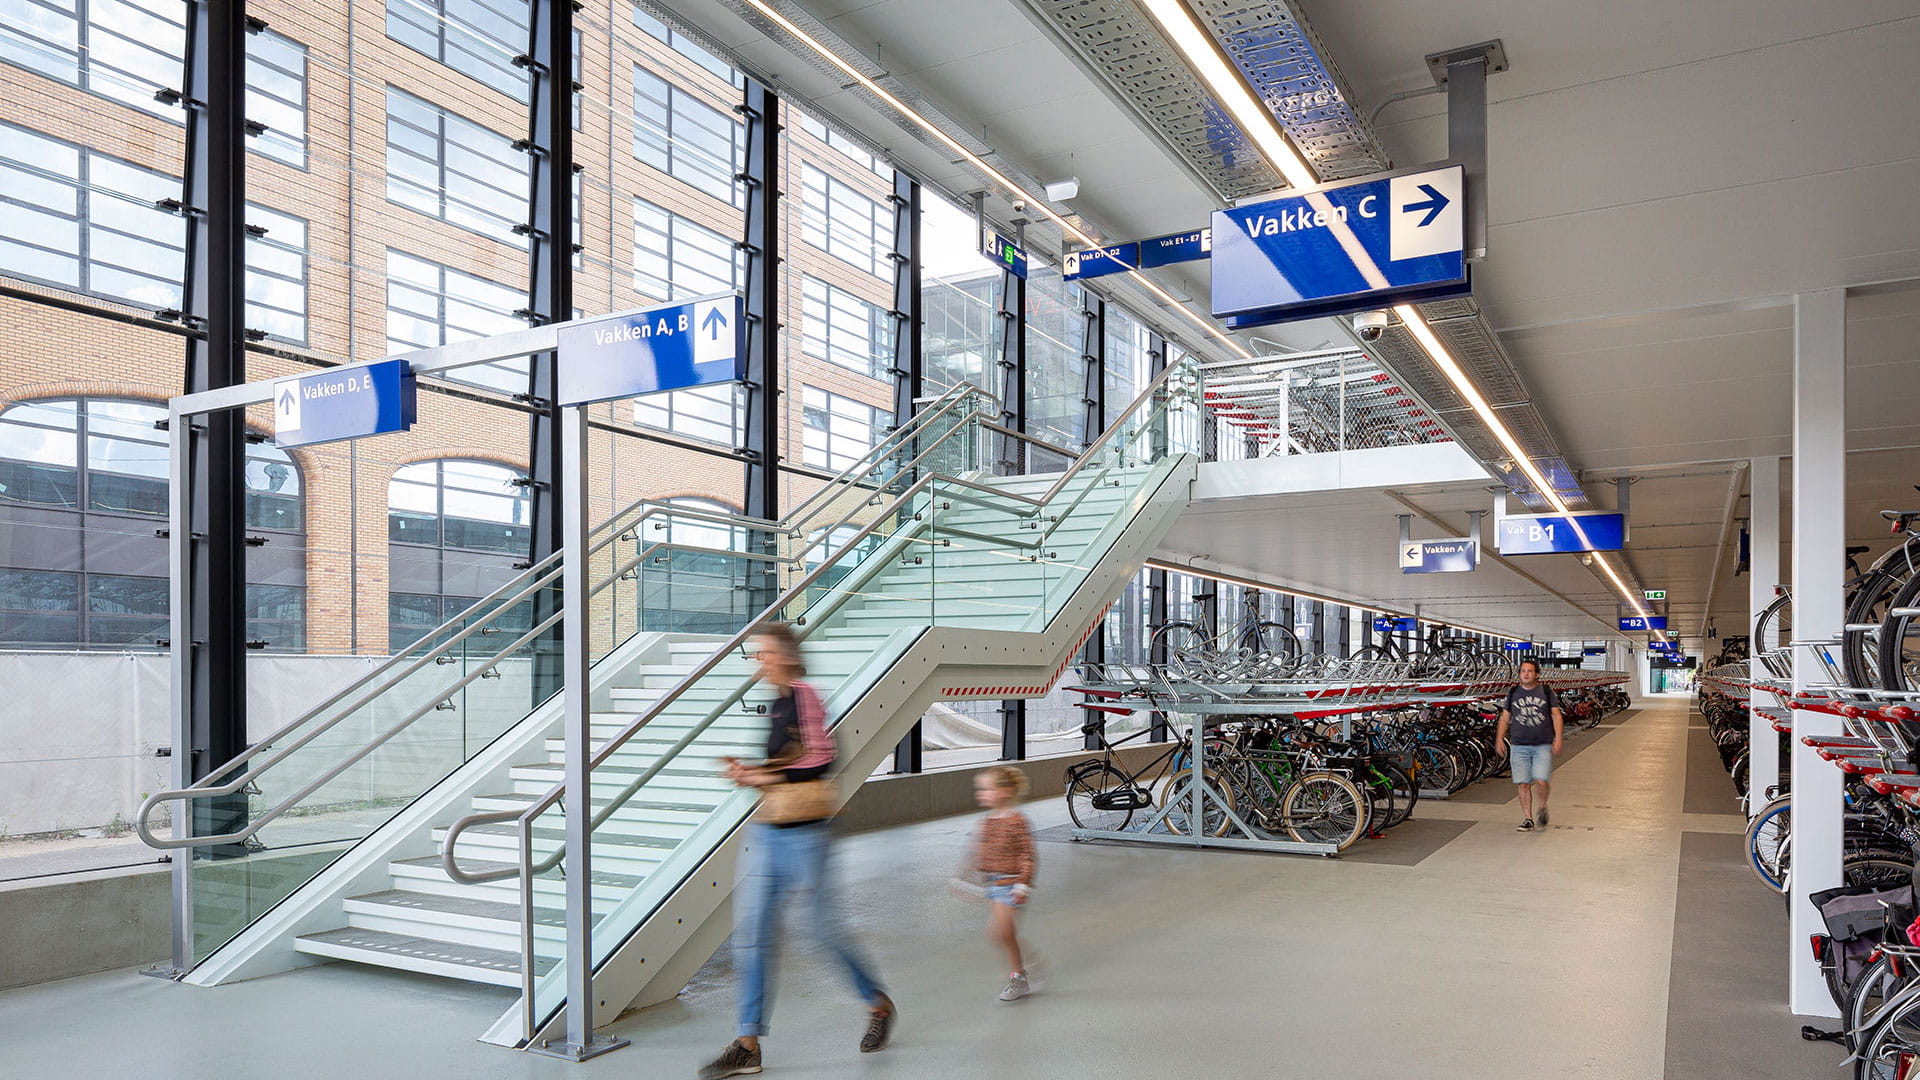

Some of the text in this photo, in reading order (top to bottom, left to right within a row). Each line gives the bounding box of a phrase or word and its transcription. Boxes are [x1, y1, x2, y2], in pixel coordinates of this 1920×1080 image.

[1245, 195, 1377, 239] Vakken C
[1160, 239, 1174, 248] Vak
[1080, 252, 1094, 261] Vak
[594, 314, 689, 346] Vakken A, B
[303, 374, 371, 400] Vakken D, E
[1507, 524, 1555, 543] Vak B1
[1424, 544, 1465, 555] Vakken A
[1630, 619, 1642, 627] B2
